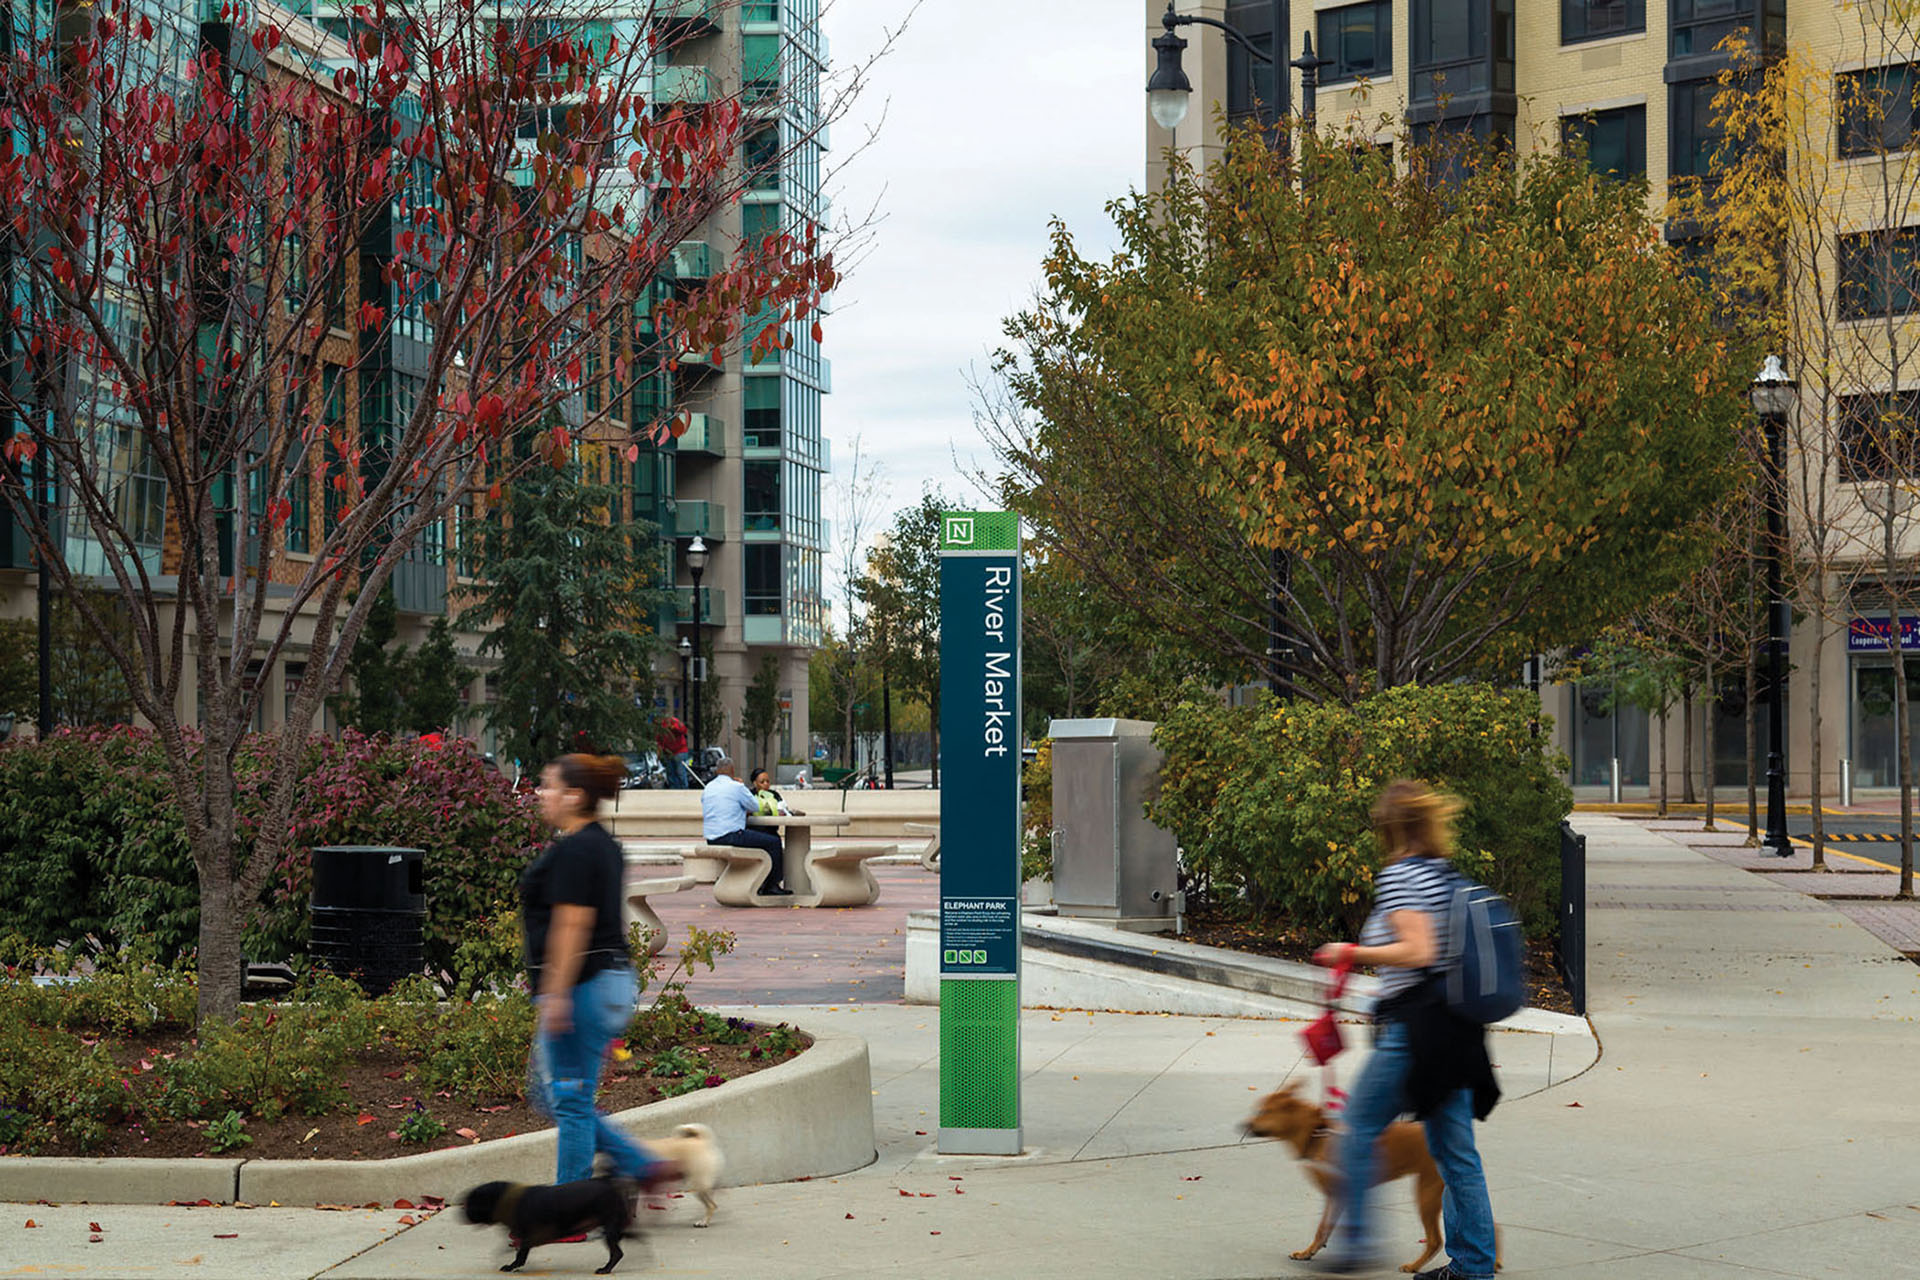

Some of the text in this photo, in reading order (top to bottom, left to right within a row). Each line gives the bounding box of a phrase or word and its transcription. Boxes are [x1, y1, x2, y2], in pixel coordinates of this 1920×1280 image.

[953, 523, 967, 538] N
[1852, 621, 1911, 633] Steves
[1851, 633, 1912, 647] Cooperati Sool
[985, 567, 1011, 757] River Market
[944, 901, 1006, 910] ELEPHANT PARK
